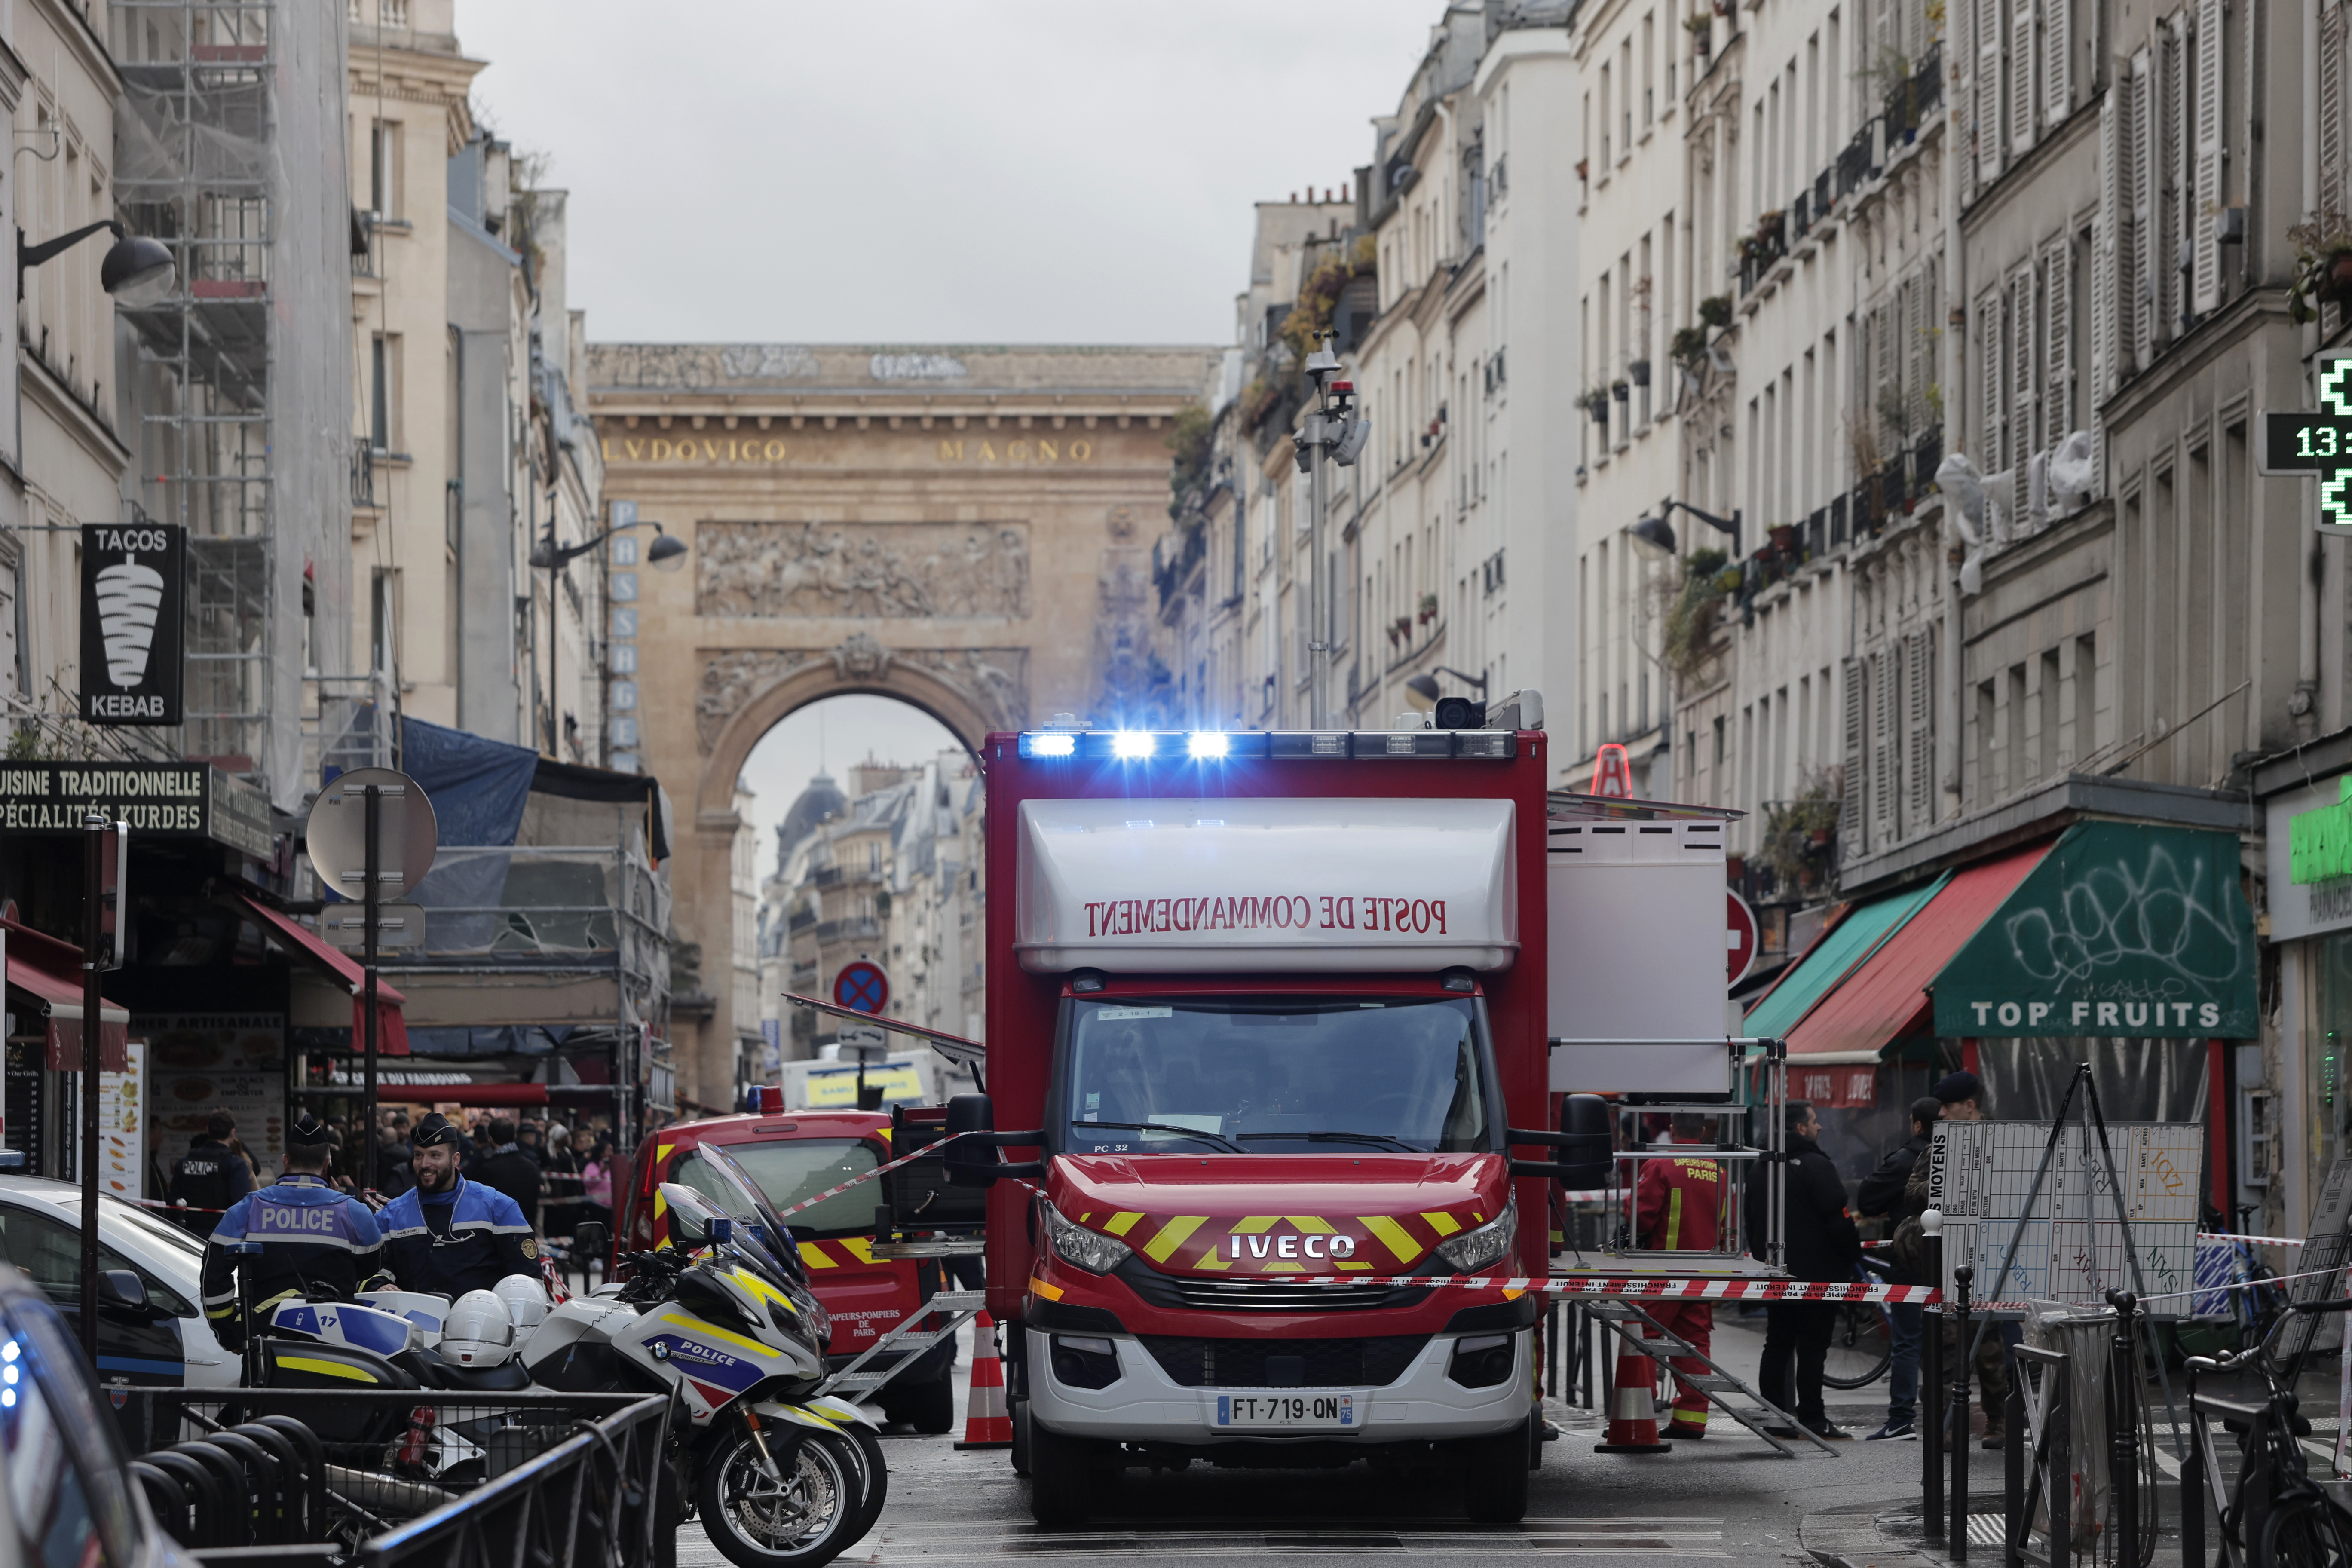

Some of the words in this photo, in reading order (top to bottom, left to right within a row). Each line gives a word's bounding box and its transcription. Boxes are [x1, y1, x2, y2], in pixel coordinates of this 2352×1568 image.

[603, 439, 786, 462] LVDOVICO
[939, 439, 1093, 462] MAGNO
[95, 529, 167, 552] TACOS
[91, 695, 165, 717] KEBAB
[59, 770, 201, 796] TRADITIONNELLE
[120, 805, 200, 829] KURDES
[176, 1016, 282, 1029] ARTISANALE
[1971, 1001, 2049, 1027] TOP
[2071, 1001, 2220, 1027] FRUITS
[184, 1161, 218, 1174] POLICE
[1687, 1167, 1718, 1183] PARIS
[1930, 1134, 1946, 1197] MOYENS
[261, 1207, 334, 1231] POLICE
[1231, 1235, 1355, 1259] IVECO
[2146, 1246, 2178, 1294] SAN
[320, 1315, 337, 1328] 17
[853, 1328, 876, 1337] PARIS
[858, 1320, 870, 1328] DE
[680, 1341, 736, 1366] POLICE
[1234, 1398, 1338, 1419] FT-719-QN
[1341, 1409, 1352, 1419] 75
[740, 1470, 749, 1489] brembo
